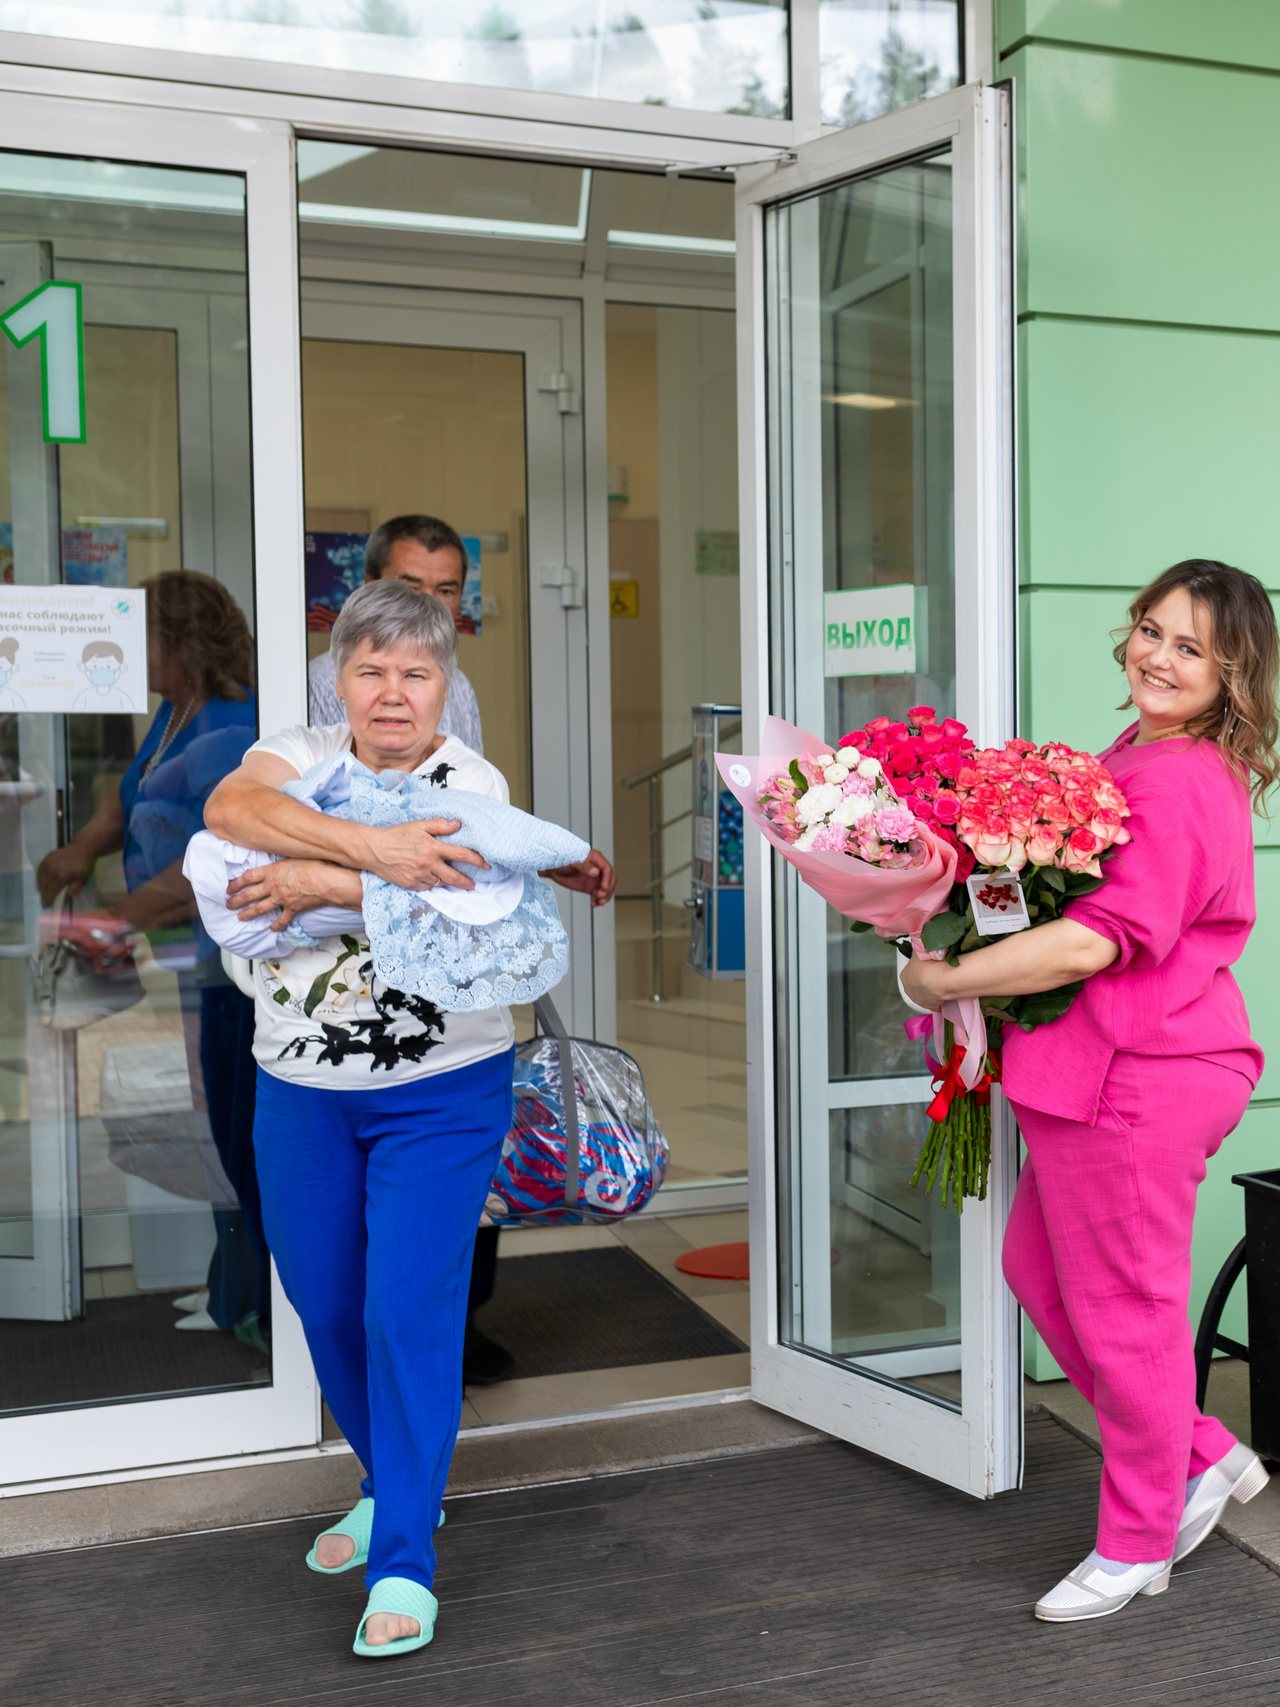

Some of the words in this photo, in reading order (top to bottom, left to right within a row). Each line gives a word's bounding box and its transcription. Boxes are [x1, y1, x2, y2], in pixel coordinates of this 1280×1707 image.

[0, 280, 87, 444] 1
[27, 610, 105, 622] соблюдают
[60, 625, 111, 635] режим!
[827, 617, 912, 651] ВЫХОД
